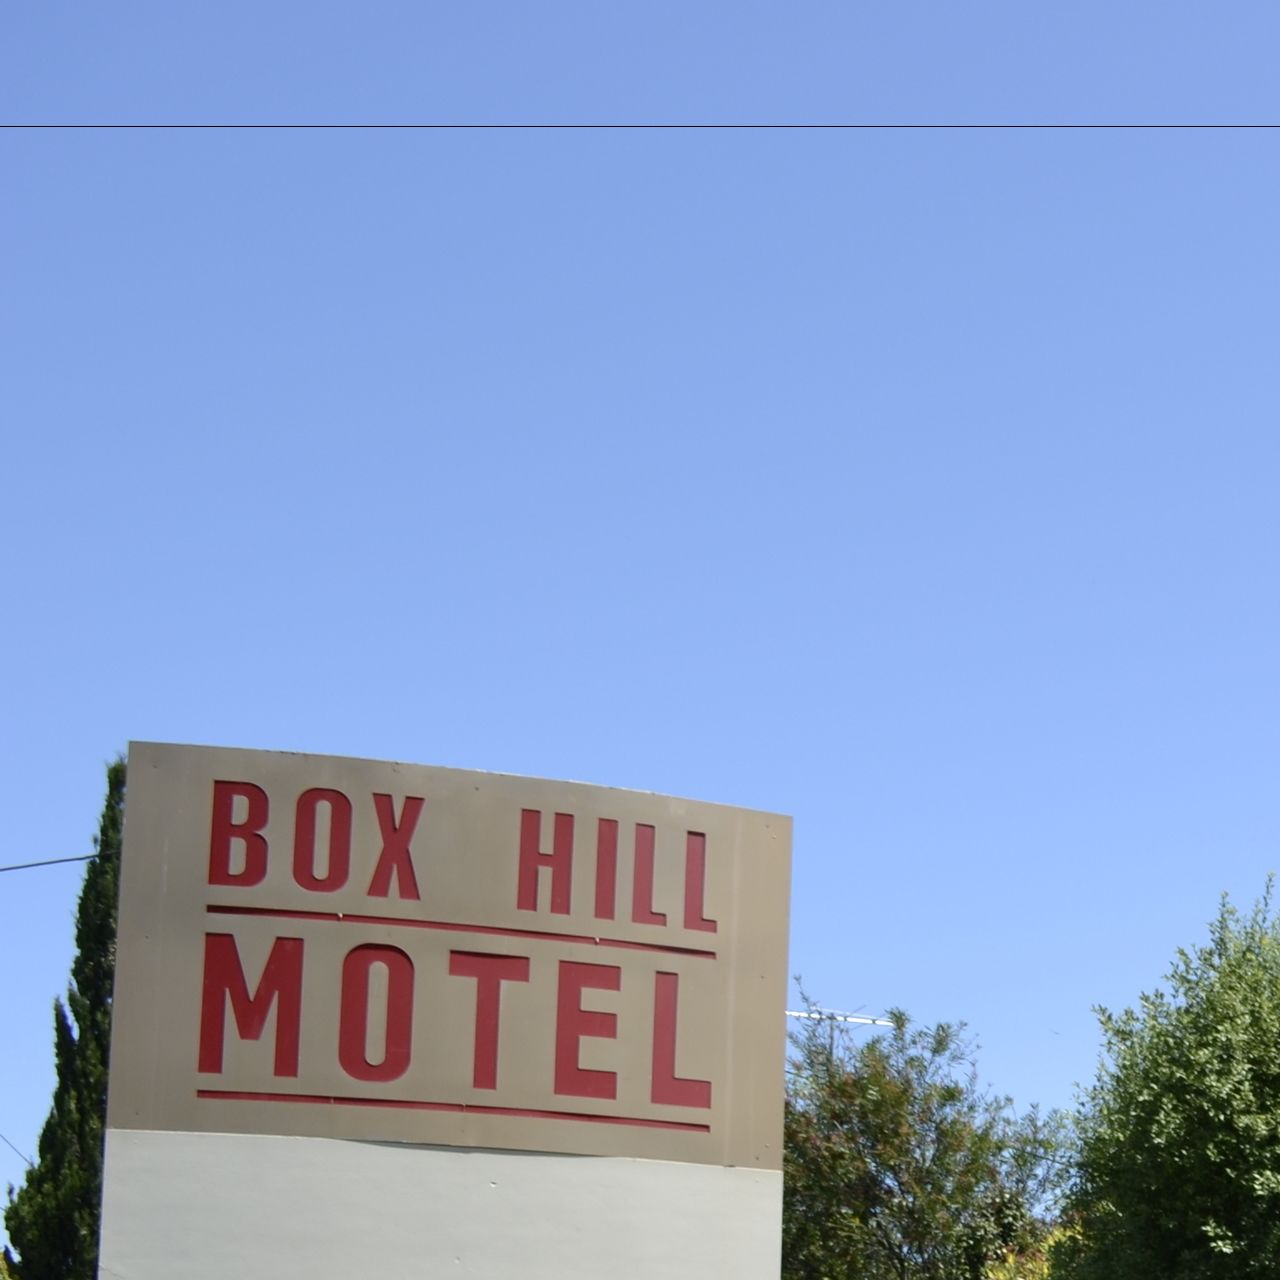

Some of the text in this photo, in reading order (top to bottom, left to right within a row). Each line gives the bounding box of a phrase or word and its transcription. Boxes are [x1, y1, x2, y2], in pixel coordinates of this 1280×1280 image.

[207, 779, 718, 933] BOX HILL
[198, 931, 713, 1109] MOTEL
